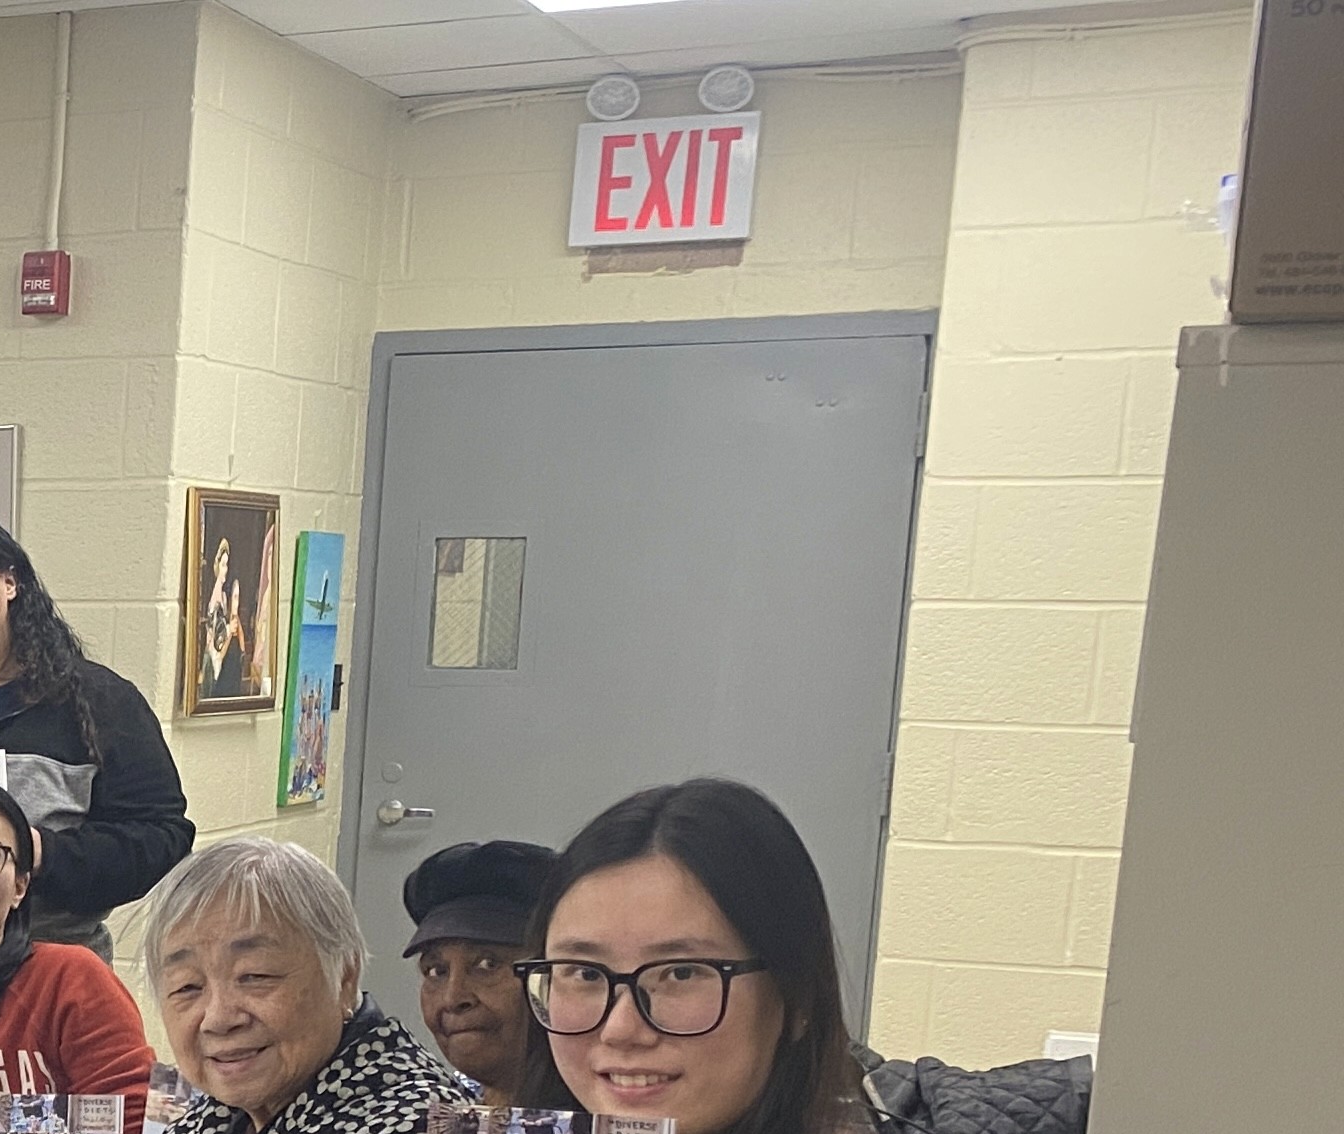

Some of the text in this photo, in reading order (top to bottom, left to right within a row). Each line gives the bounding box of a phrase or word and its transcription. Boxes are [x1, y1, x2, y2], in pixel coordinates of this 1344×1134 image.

[593, 126, 744, 233] EXIT
[24, 279, 51, 291] FIRE
[615, 1120, 658, 1131] DIVERSE
